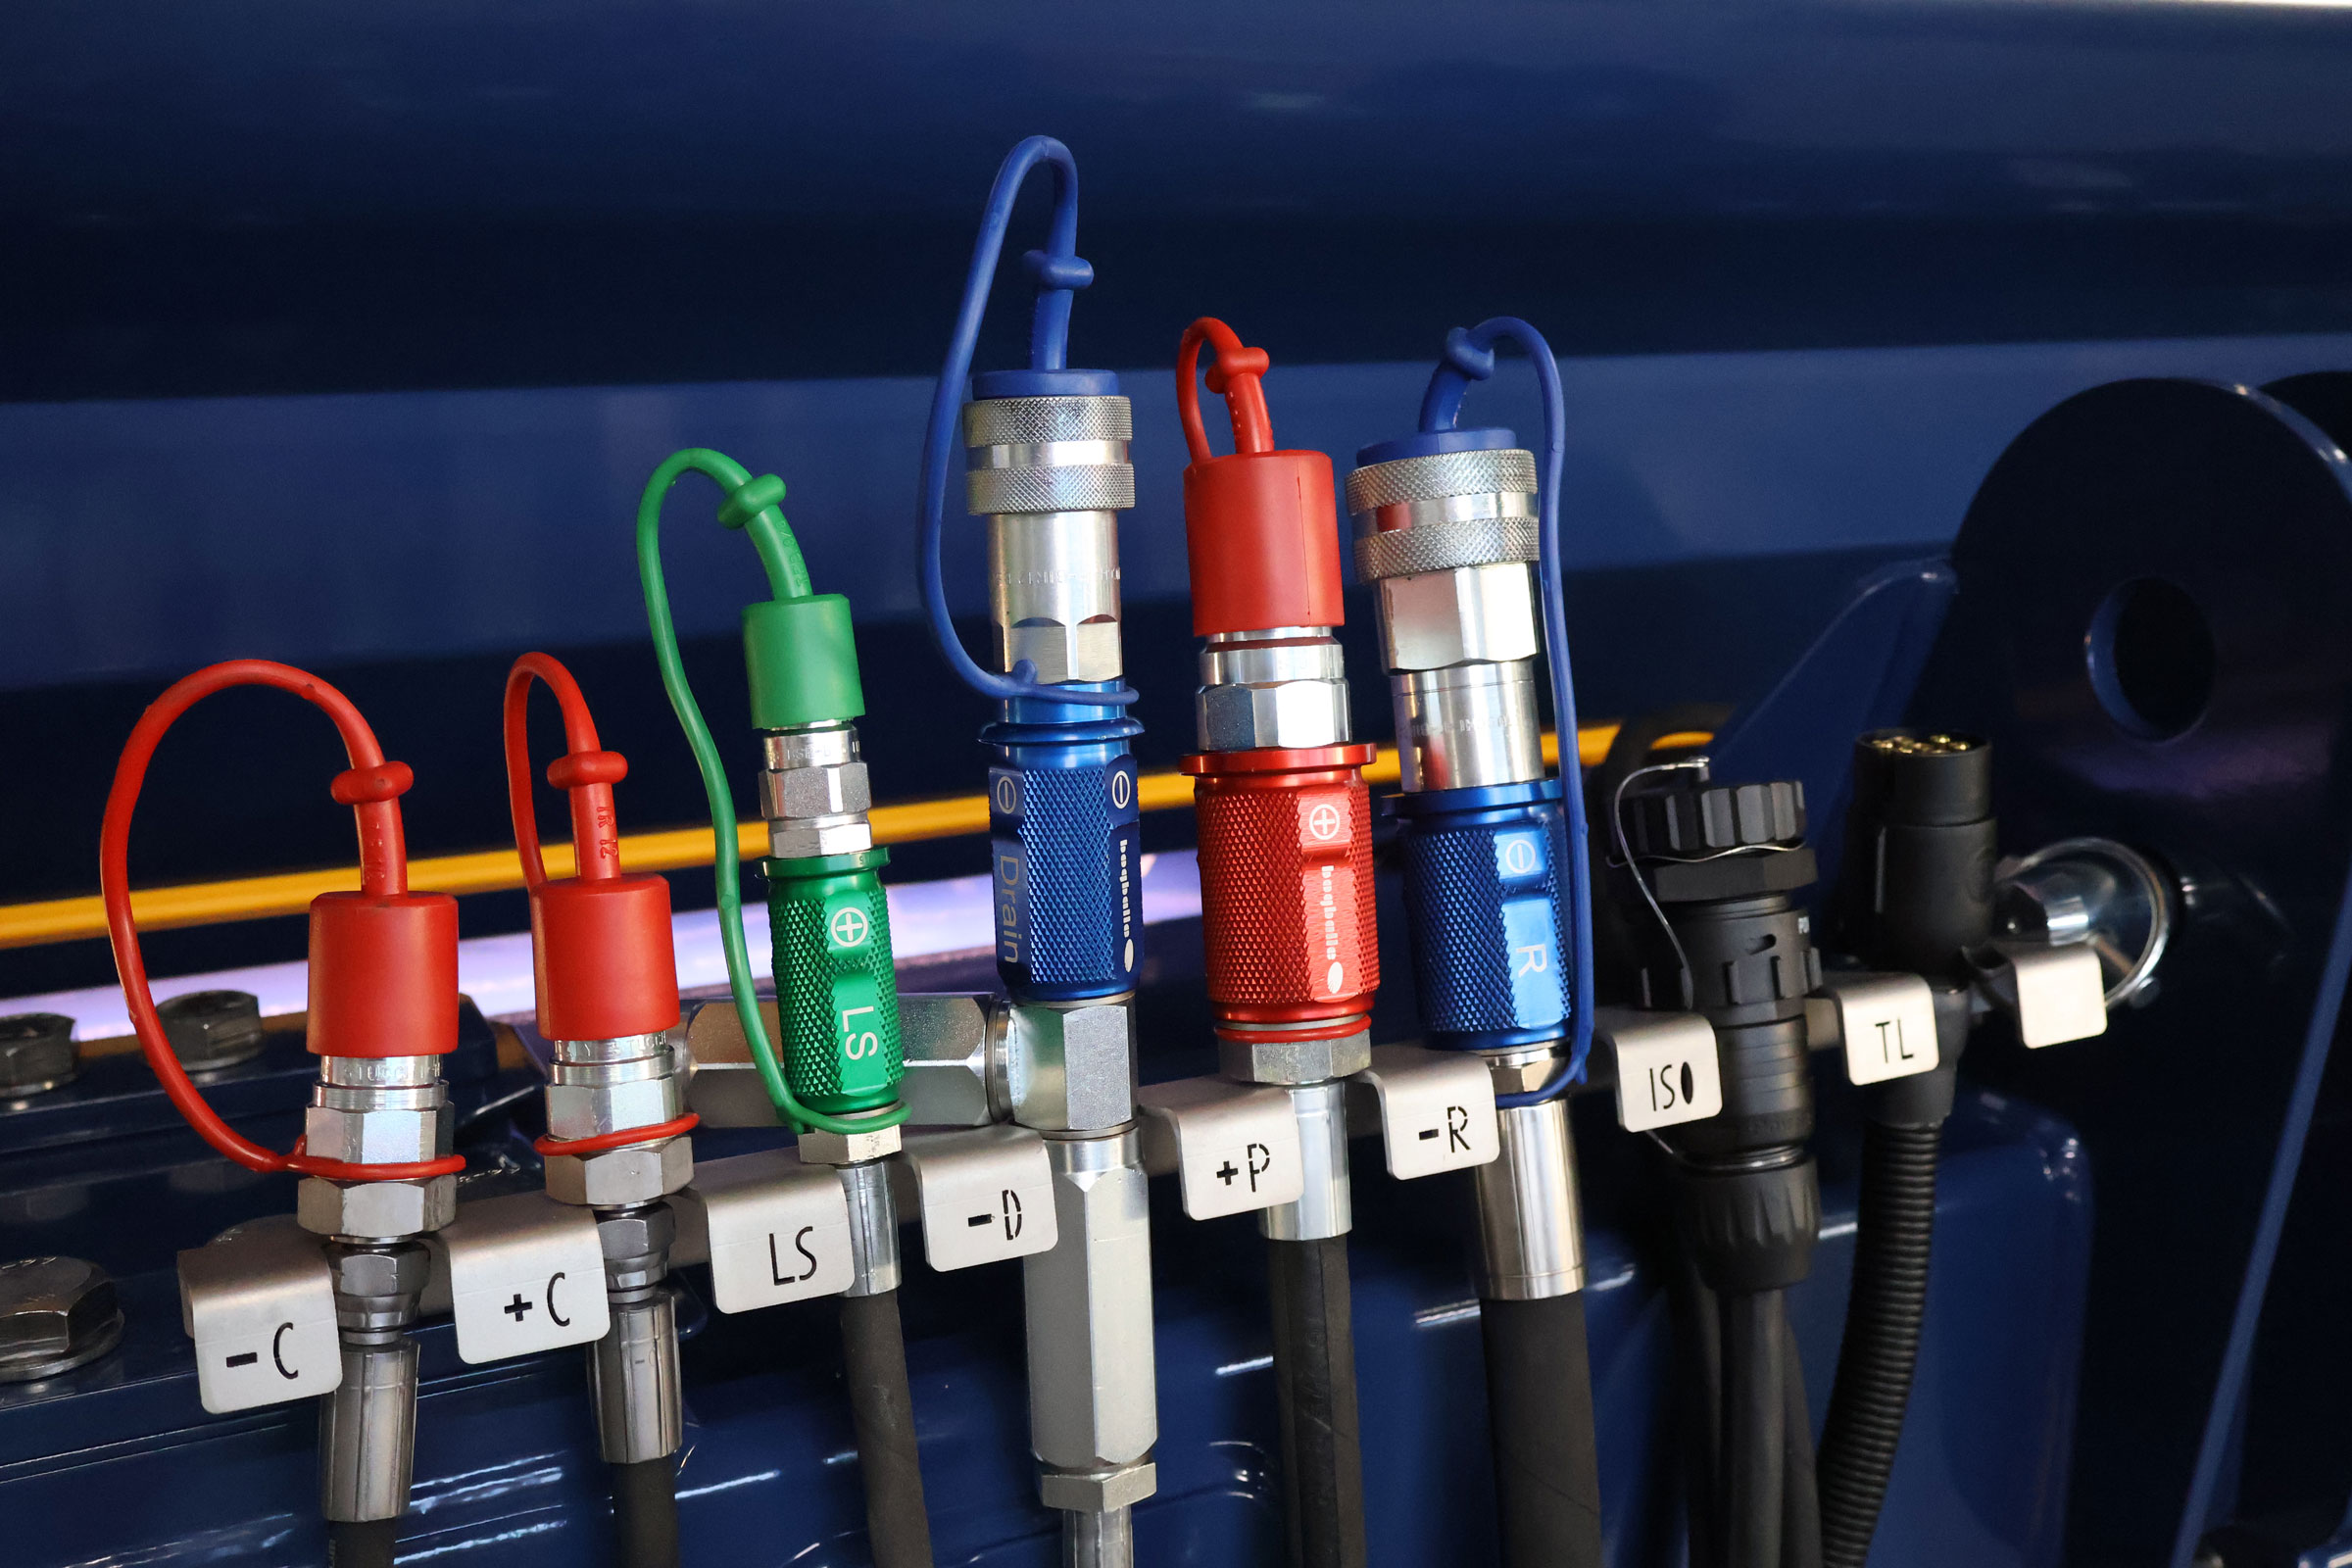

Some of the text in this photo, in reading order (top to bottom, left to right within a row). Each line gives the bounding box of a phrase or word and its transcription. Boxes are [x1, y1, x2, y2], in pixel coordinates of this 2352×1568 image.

[599, 839, 618, 859] 12
[999, 855, 1020, 964] Drain
[1515, 944, 1547, 978] R
[842, 1005, 878, 1060] LS
[1875, 1016, 1914, 1064] TL
[1649, 1060, 1694, 1112] ISO
[768, 1226, 817, 1286] LS
